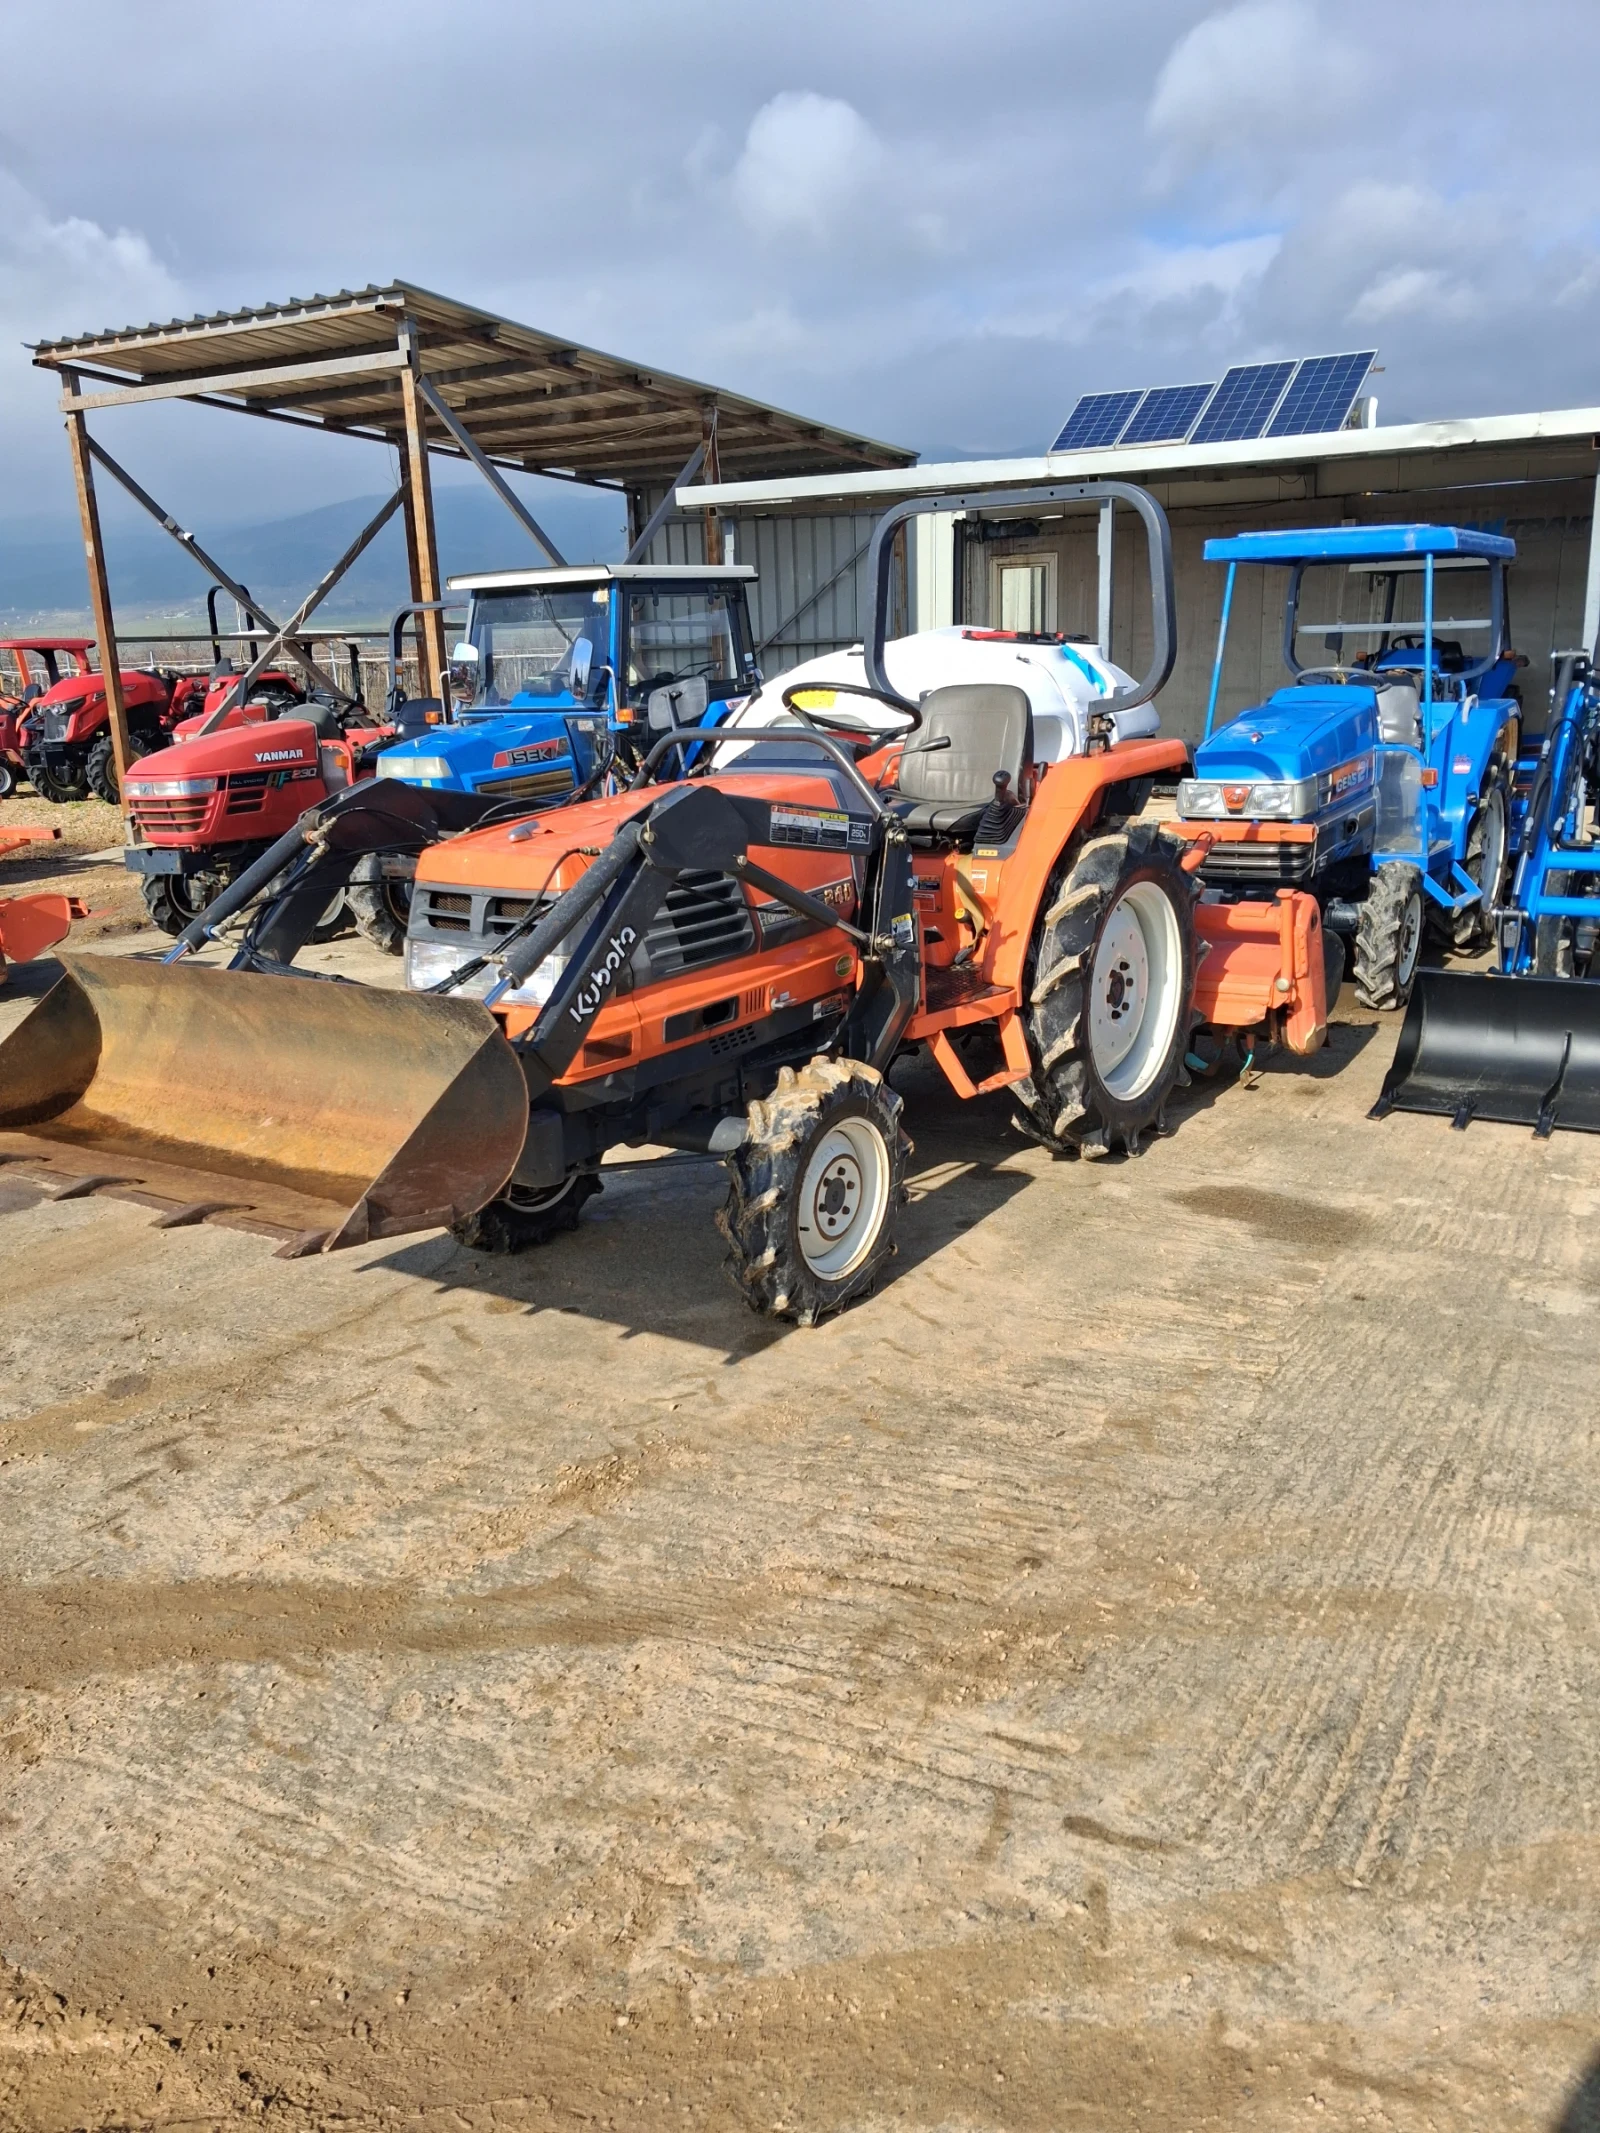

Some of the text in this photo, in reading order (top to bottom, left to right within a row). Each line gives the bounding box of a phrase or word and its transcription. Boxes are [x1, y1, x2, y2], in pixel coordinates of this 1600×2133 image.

[254, 749, 303, 762] YANMAR
[509, 747, 556, 764] ISEKI
[569, 927, 636, 1023] Kubota
